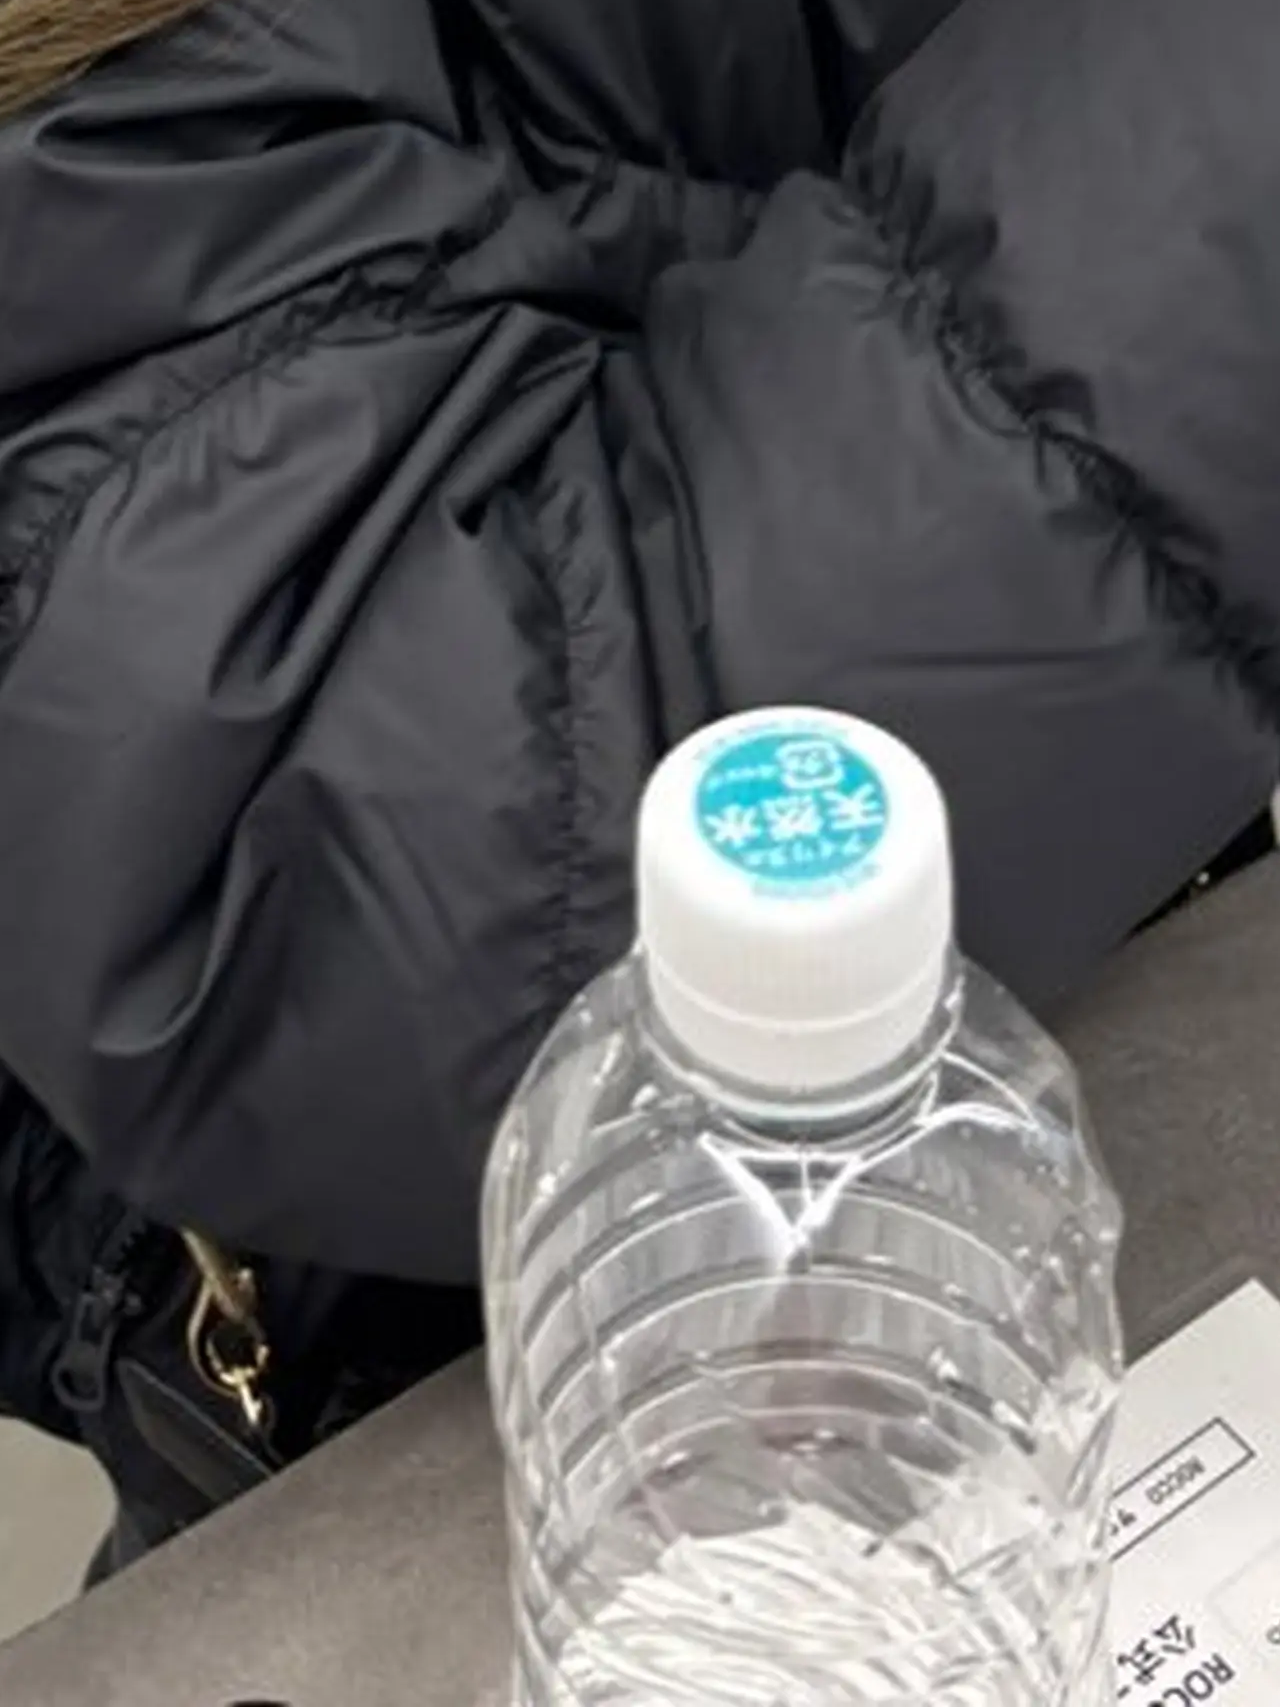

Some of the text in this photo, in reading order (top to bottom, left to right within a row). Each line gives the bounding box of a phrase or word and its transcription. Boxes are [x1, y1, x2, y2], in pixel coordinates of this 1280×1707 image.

[704, 782, 884, 850] 天然水
[1118, 1613, 1196, 1698] 公式
